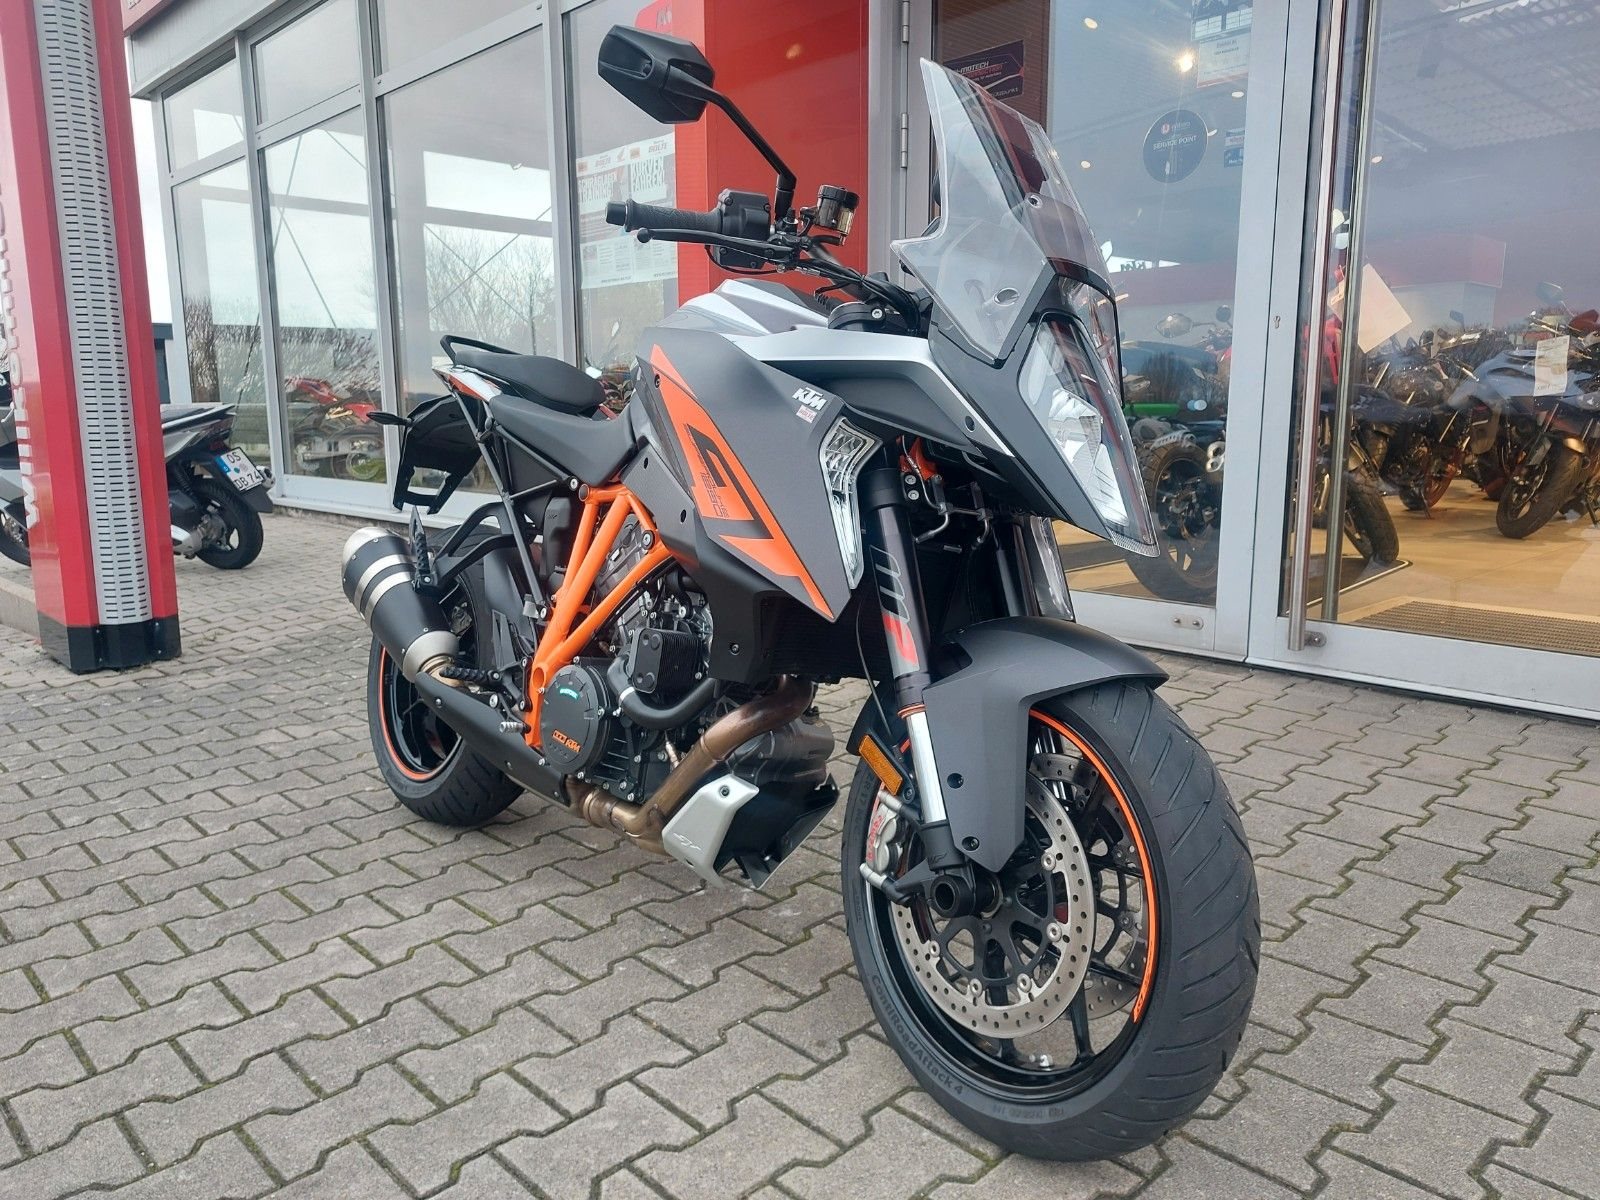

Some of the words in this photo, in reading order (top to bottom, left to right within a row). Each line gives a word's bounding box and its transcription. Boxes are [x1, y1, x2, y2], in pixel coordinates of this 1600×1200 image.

[1178, 135, 1198, 145] POINT
[791, 386, 828, 411] KTM
[227, 451, 241, 463] OS
[871, 974, 953, 1088] ContiRoadAttack
